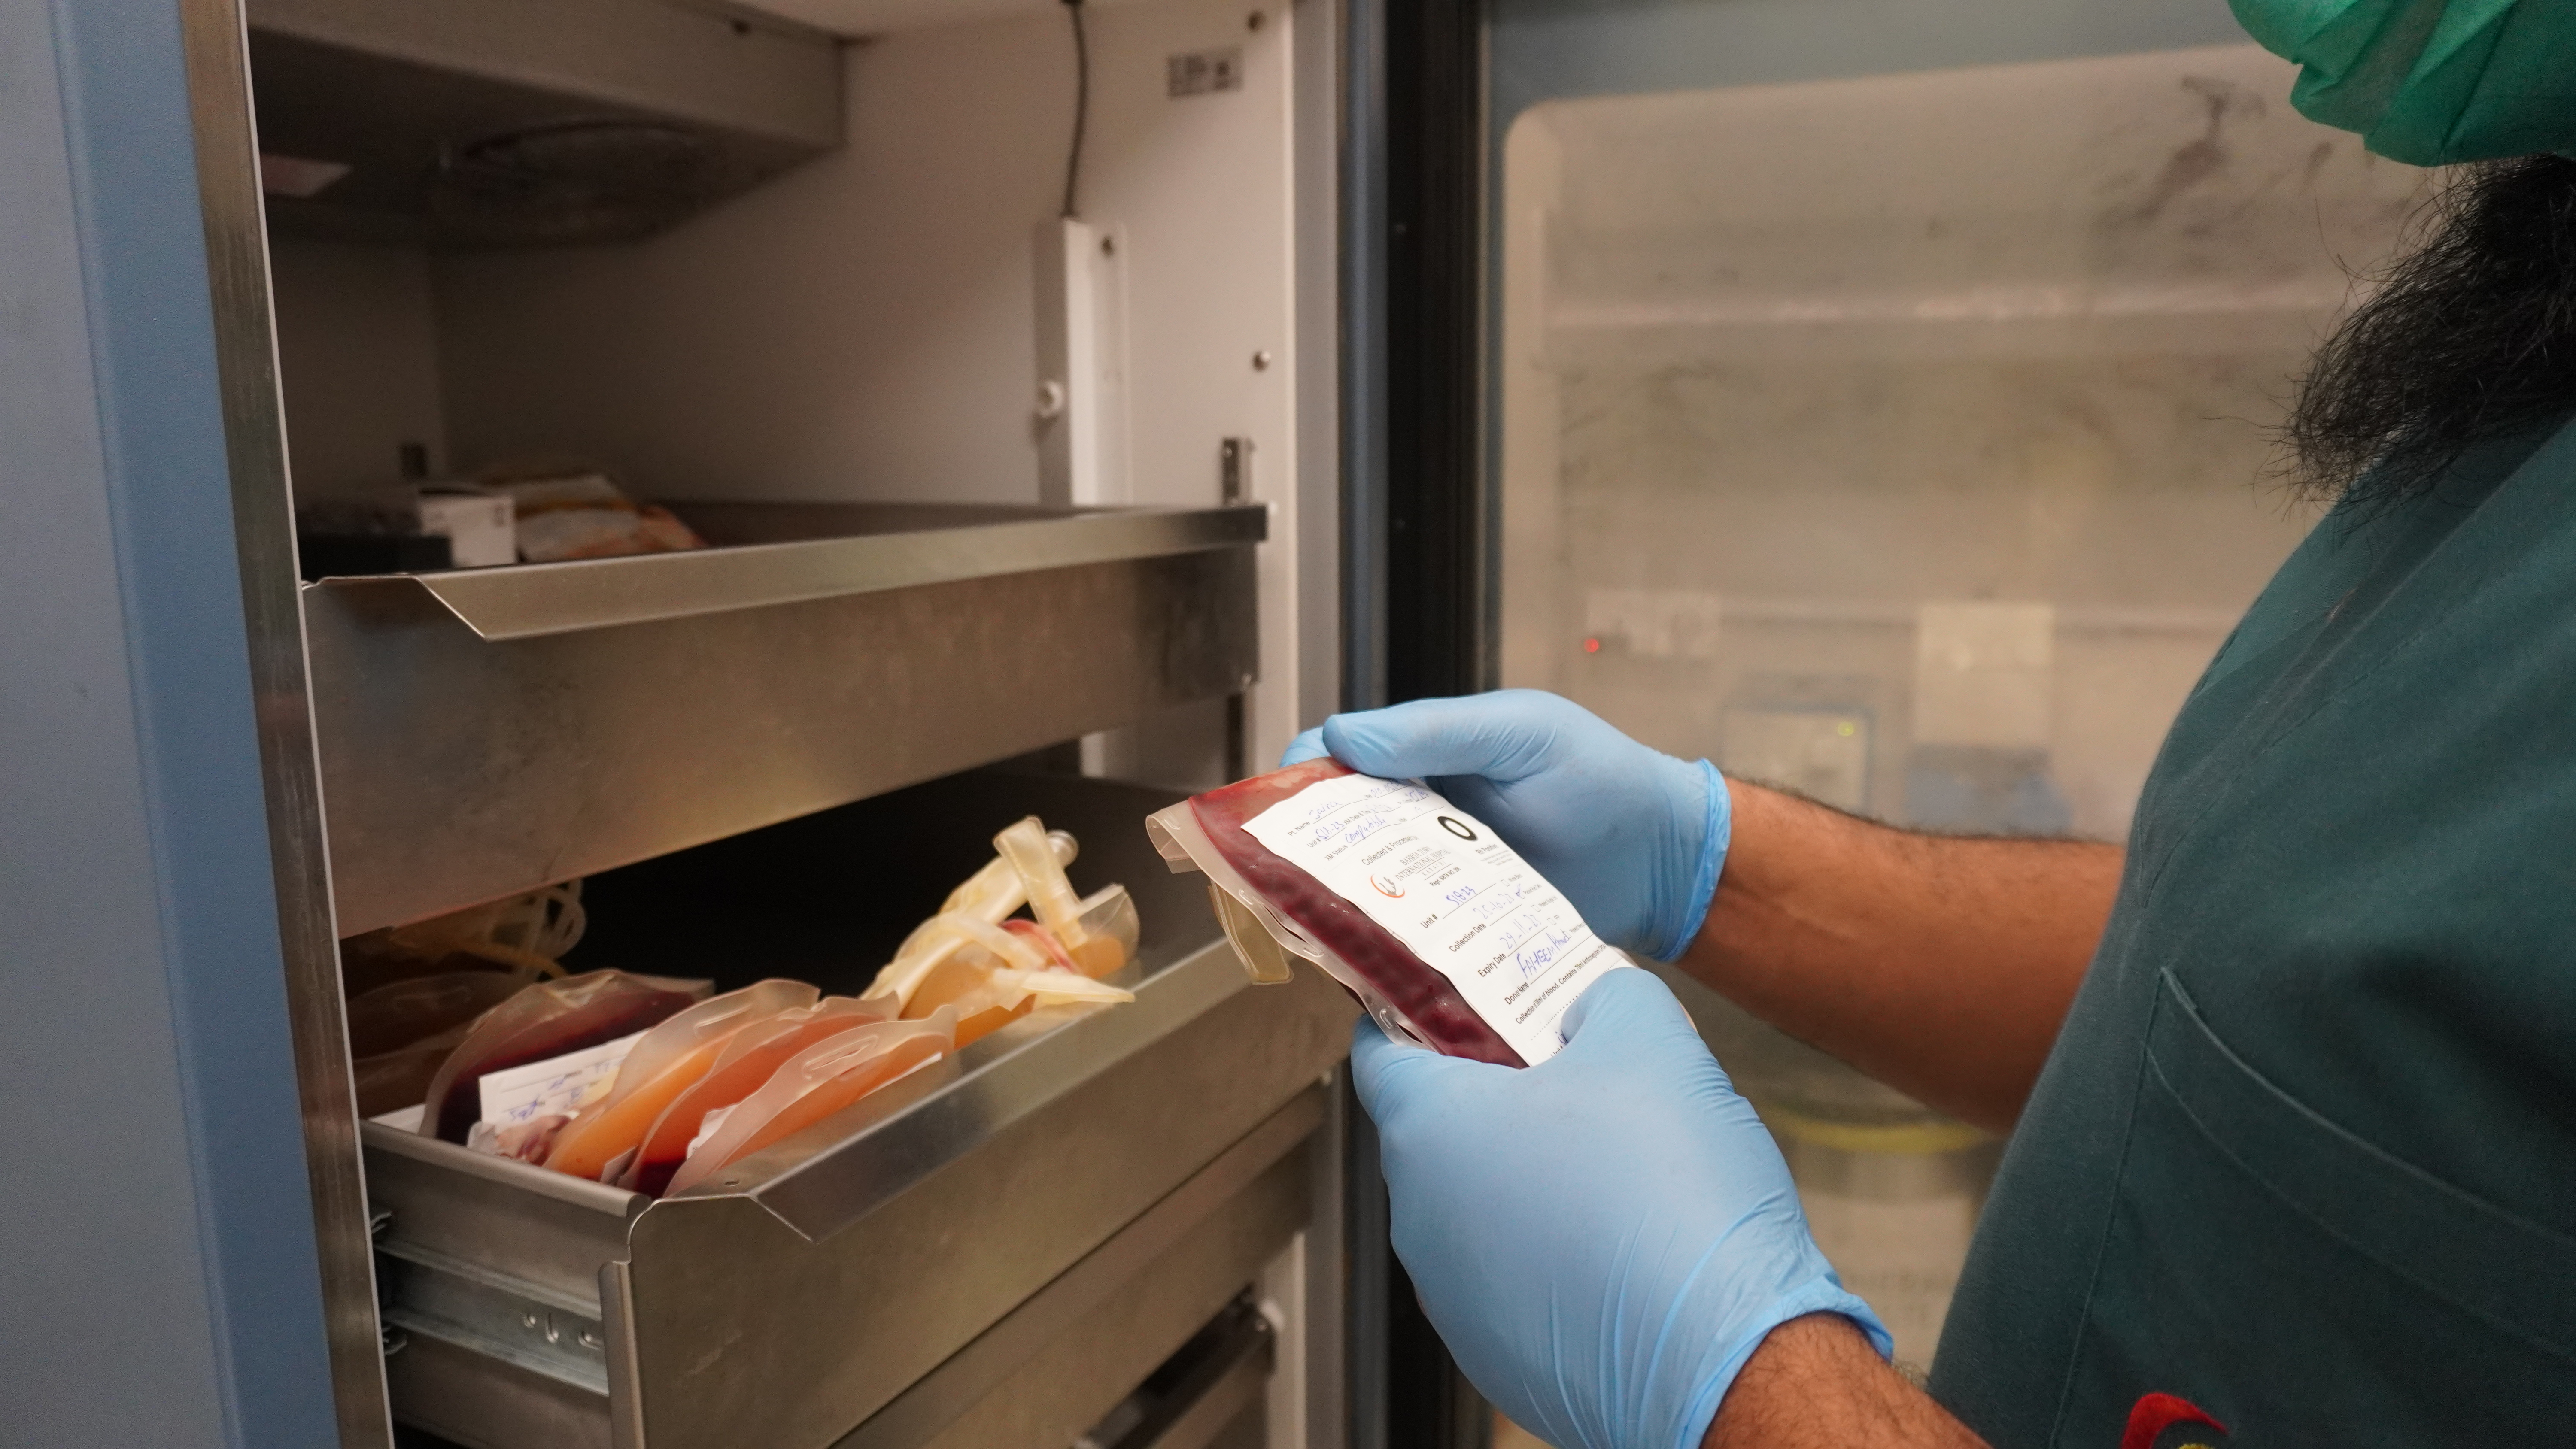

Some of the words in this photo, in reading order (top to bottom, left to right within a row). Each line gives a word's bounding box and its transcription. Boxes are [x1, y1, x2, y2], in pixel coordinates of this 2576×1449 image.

[1294, 821, 1310, 831] Name
[1352, 813, 1361, 821] Date
[1307, 839, 1318, 848] Unit
[1332, 845, 1348, 856] Status
[1361, 847, 1388, 865] Collected
[1389, 836, 1415, 849] Processed
[1394, 855, 1433, 881] INTERNATIONAL
[1431, 849, 1452, 860] HOSPITAL
[1399, 852, 1421, 866] BAHRIA
[1417, 846, 1433, 855] TOWN
[1420, 917, 1434, 928] Unit
[1449, 930, 1477, 952] Collection
[1473, 923, 1487, 933] Date
[1477, 961, 1498, 978] Expiry
[1493, 952, 1507, 964] Date
[1504, 988, 1521, 1005] Donor
[1517, 982, 1529, 993] Name
[1516, 1006, 1536, 1024] Collection
[1545, 982, 1560, 996] blood.
[1558, 968, 1577, 985] Contains
[1582, 948, 1601, 965] Anticoagulant
